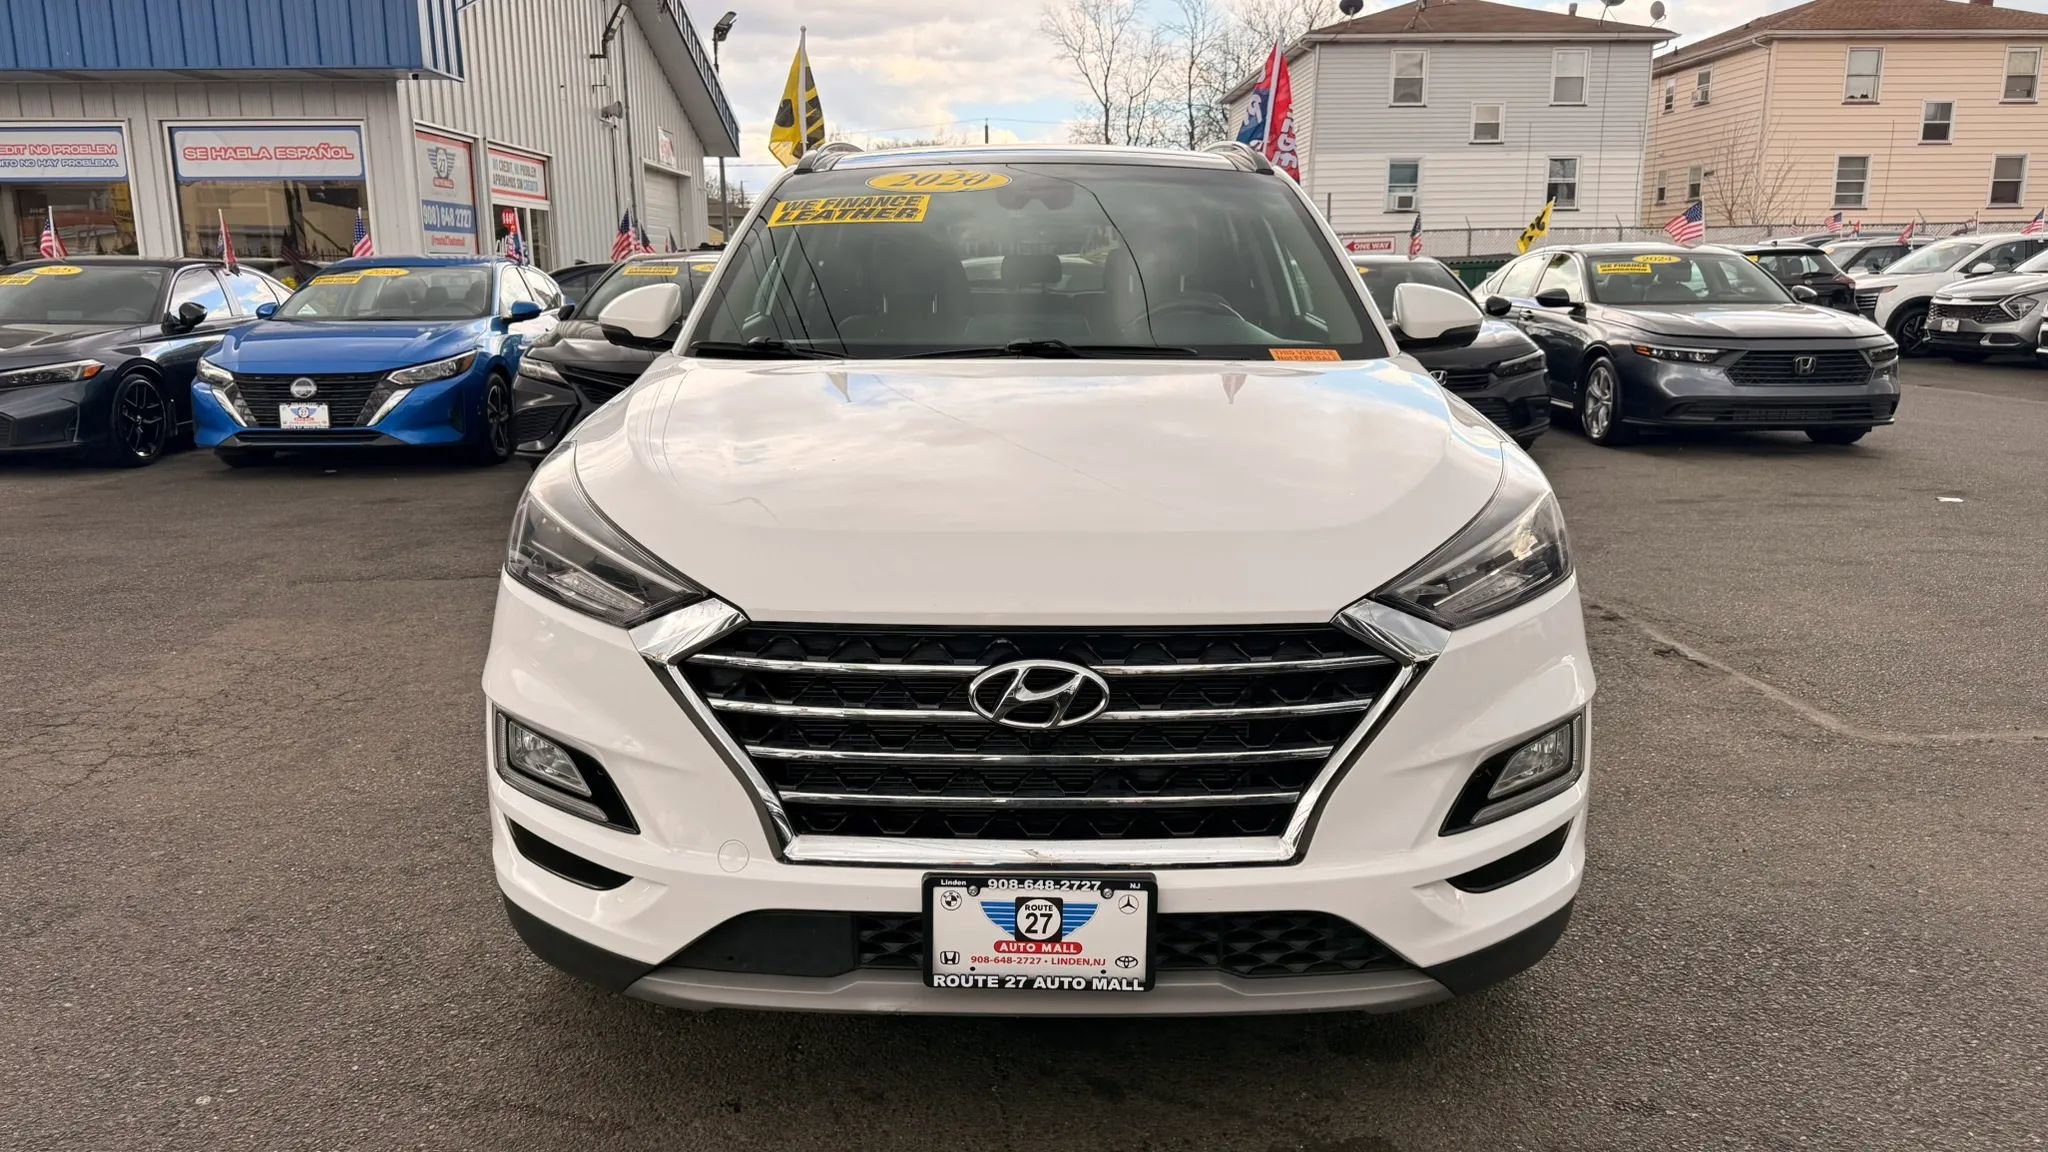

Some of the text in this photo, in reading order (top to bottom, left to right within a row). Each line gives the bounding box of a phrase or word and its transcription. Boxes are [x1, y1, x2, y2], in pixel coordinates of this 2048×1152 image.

[29, 144, 51, 155] NO
[52, 144, 118, 155] PROBLEM
[184, 142, 354, 160] SE HABLA ESPAÑOL
[20, 158, 36, 167] NO
[37, 158, 59, 167] HAY
[61, 159, 119, 168] PROBLEMA
[888, 173, 991, 187] 2020
[780, 195, 923, 213] WE FINANCE
[440, 206, 455, 227] 648
[455, 208, 472, 228] 2727
[776, 207, 920, 223] LEATHER
[1354, 243, 1371, 251] ONE
[987, 879, 1102, 892] 908-648-2727
[1024, 904, 1053, 912] ROUTE
[1024, 913, 1053, 934] 27
[999, 942, 1077, 954] AUTO MALL
[970, 955, 1107, 967] 908-648-2727 LINDEN,NJ
[933, 975, 1145, 992] ROUTE 27 AUTO MALL
